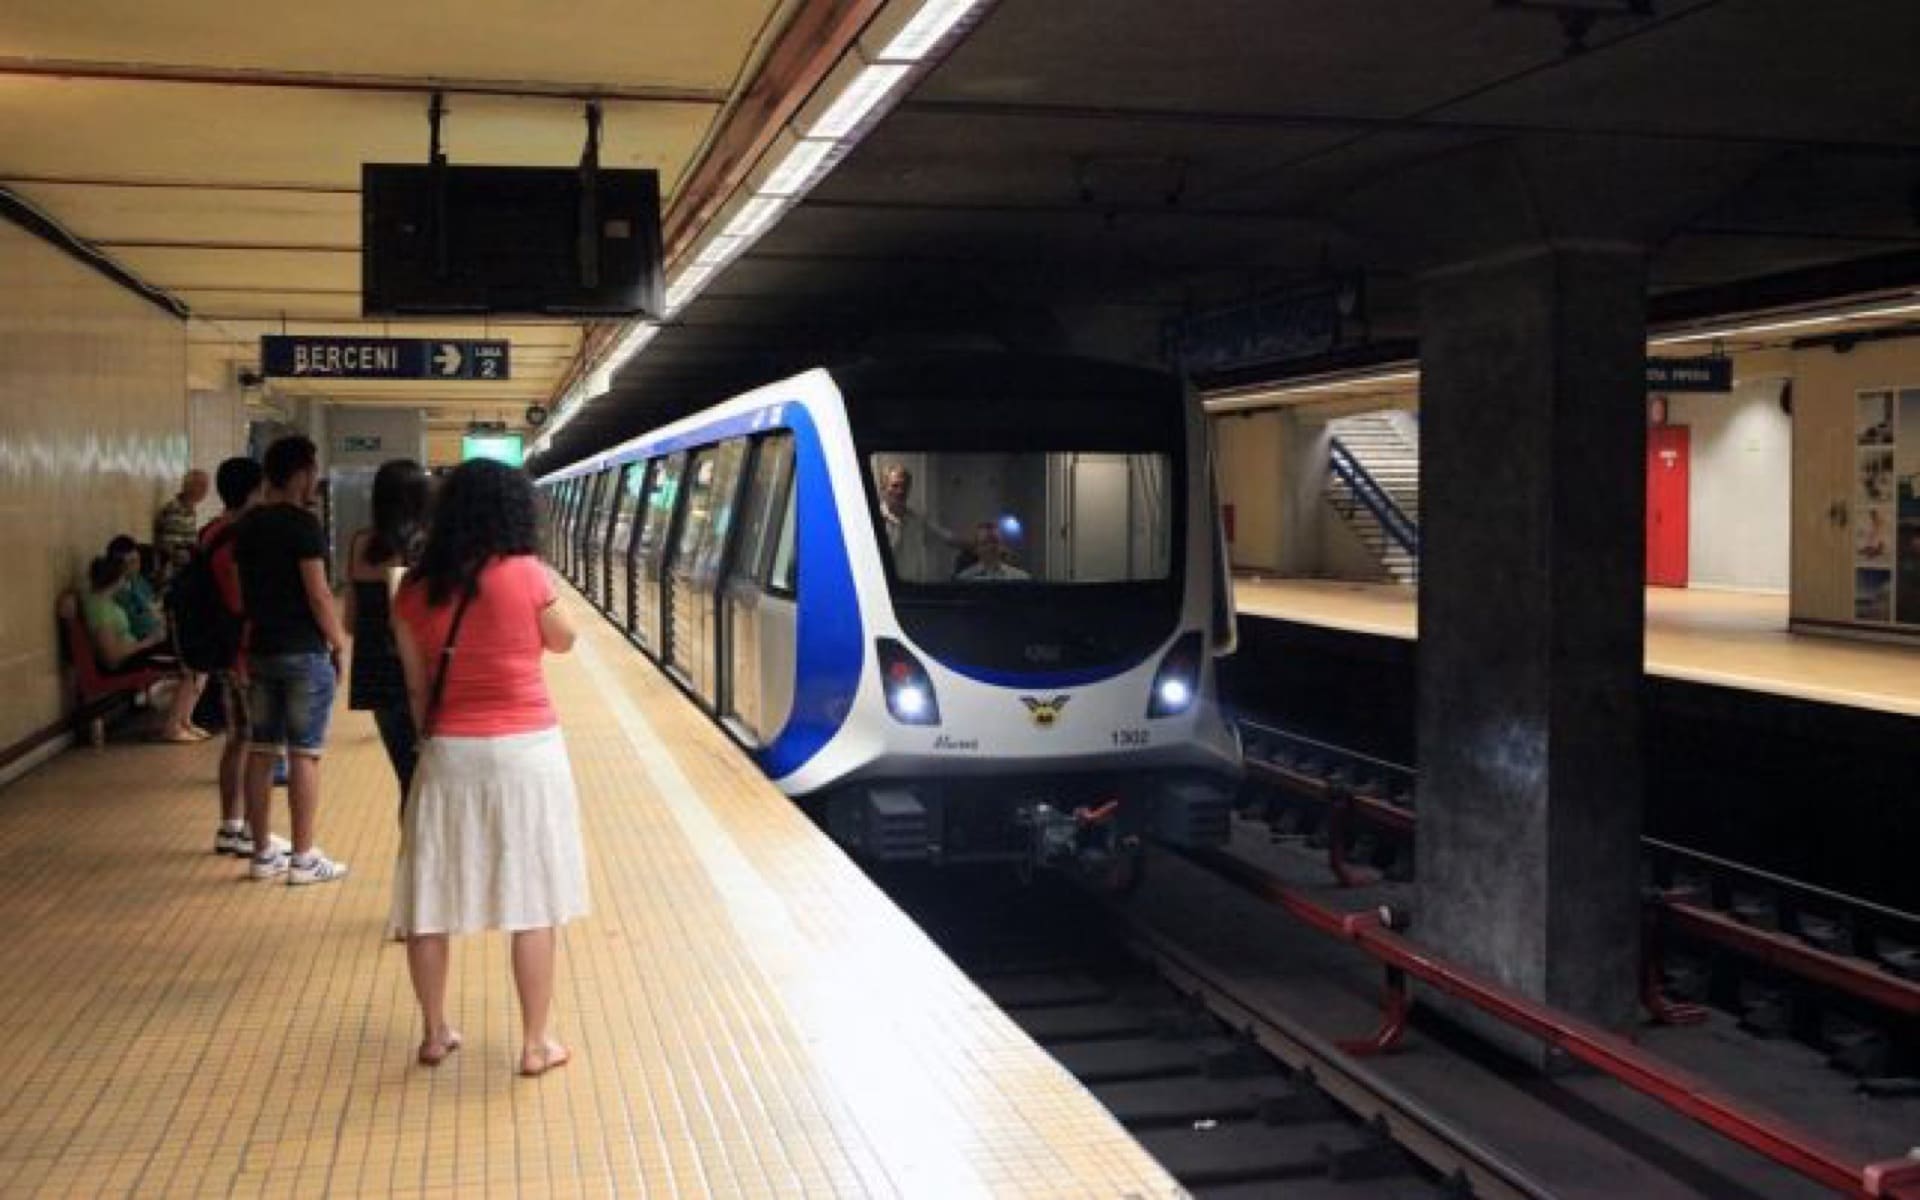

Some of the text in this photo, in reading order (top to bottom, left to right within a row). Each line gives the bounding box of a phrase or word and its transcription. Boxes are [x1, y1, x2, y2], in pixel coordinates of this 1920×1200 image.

[294, 344, 398, 370] BERCENI
[481, 358, 497, 378] 2
[1111, 729, 1151, 746] 1302
